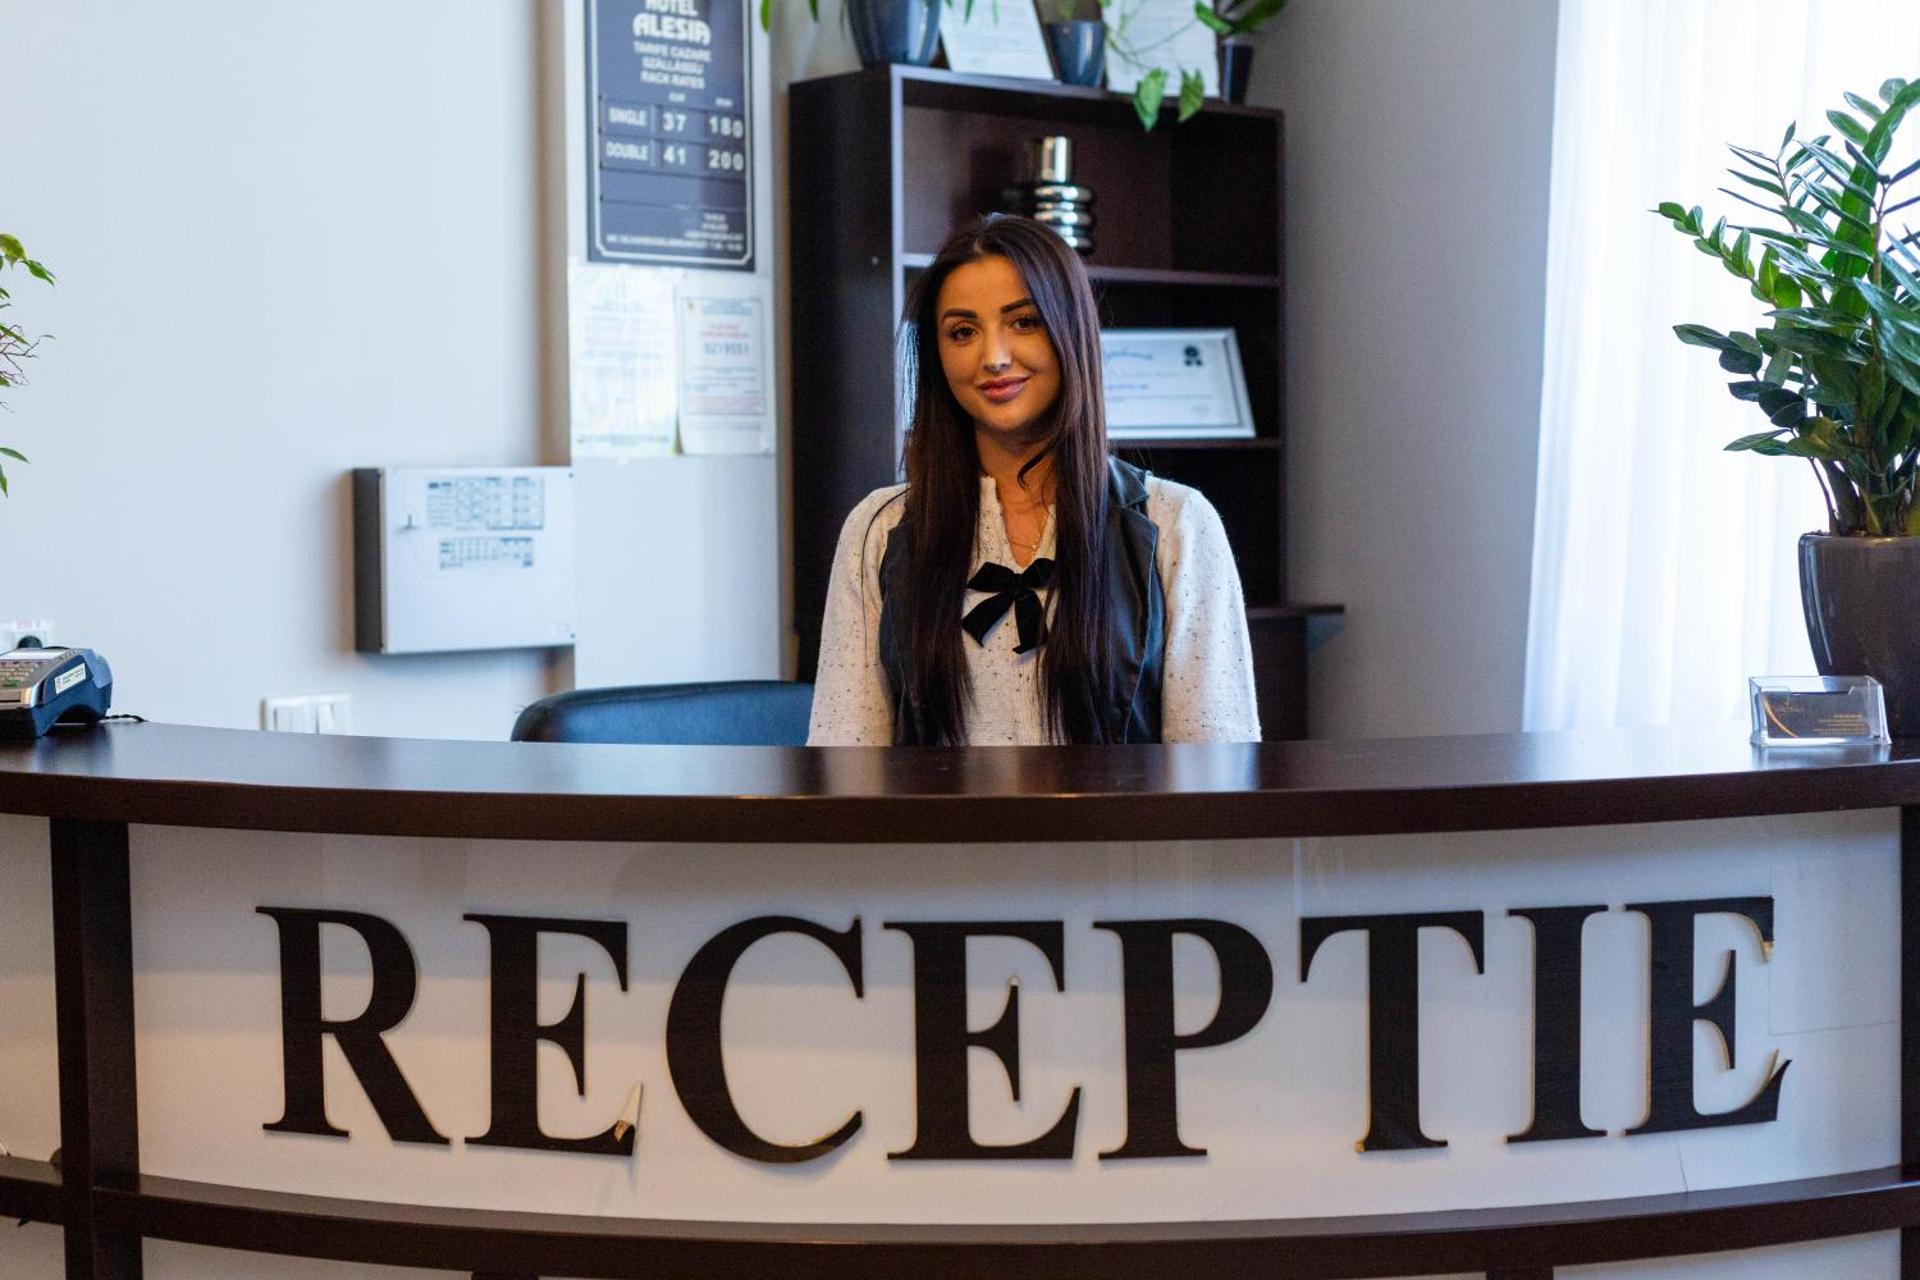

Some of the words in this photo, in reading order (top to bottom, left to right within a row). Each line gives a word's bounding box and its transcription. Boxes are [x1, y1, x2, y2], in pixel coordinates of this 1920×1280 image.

[633, 12, 712, 46] ALESIA
[608, 107, 648, 127] SINGLE
[662, 112, 687, 132] 37
[708, 116, 744, 139] 180
[606, 141, 649, 161] DOUBLE
[663, 145, 687, 165] 41
[708, 149, 744, 171] 200
[255, 896, 1792, 1166] RECEPTIE
